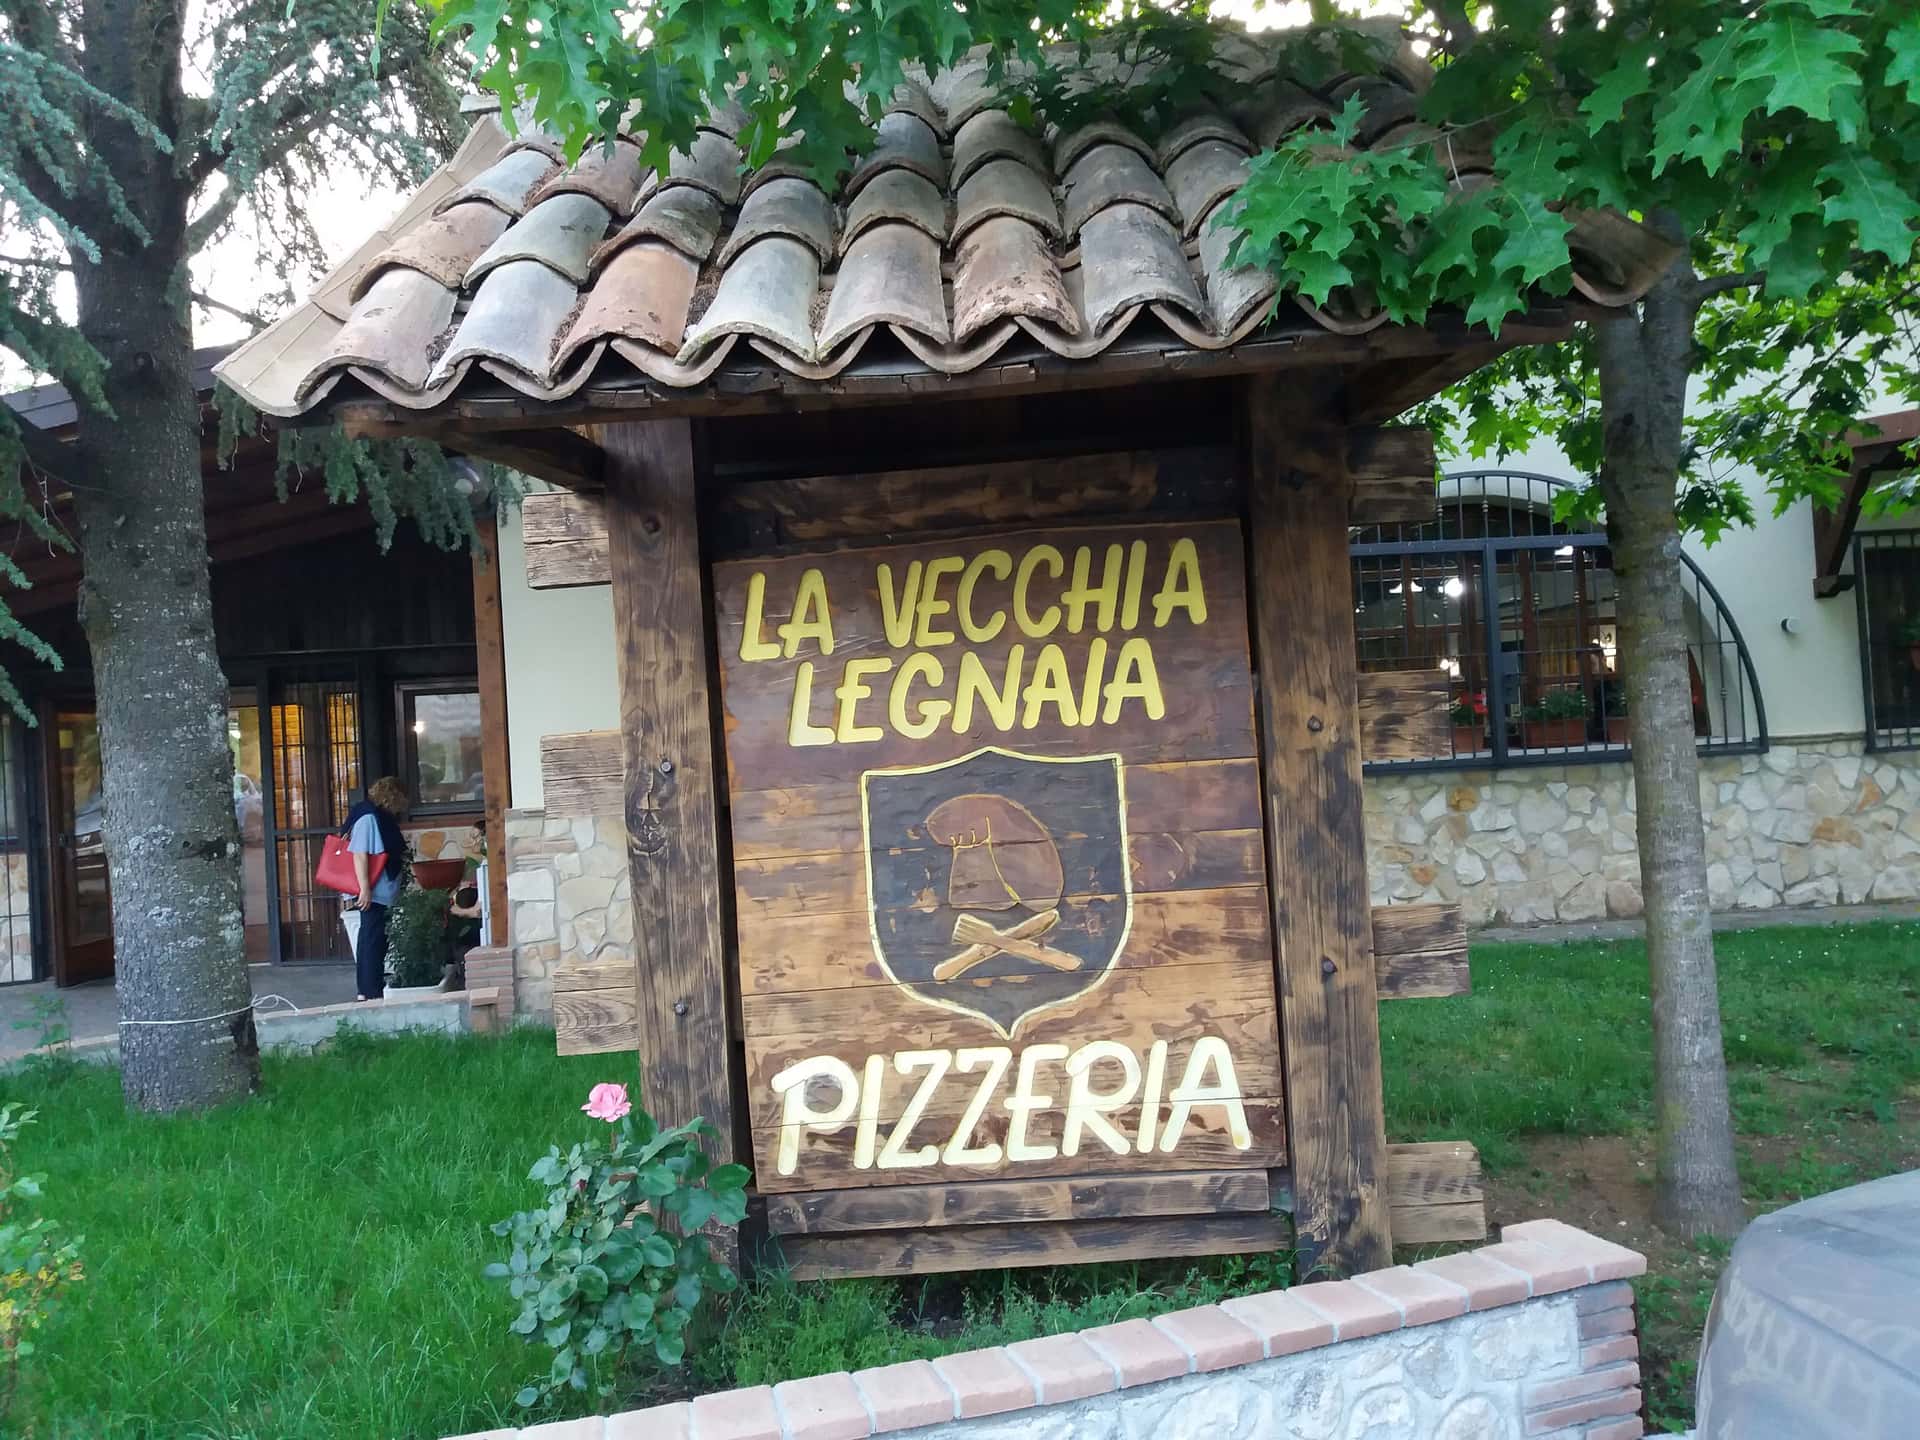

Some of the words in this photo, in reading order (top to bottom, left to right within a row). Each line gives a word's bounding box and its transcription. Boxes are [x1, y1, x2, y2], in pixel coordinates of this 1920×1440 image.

[740, 569, 835, 661] LA
[877, 538, 1207, 647] VECCHIA
[789, 637, 1165, 746] LEGNAIA
[772, 1037, 1252, 1175] PIZZERIA
